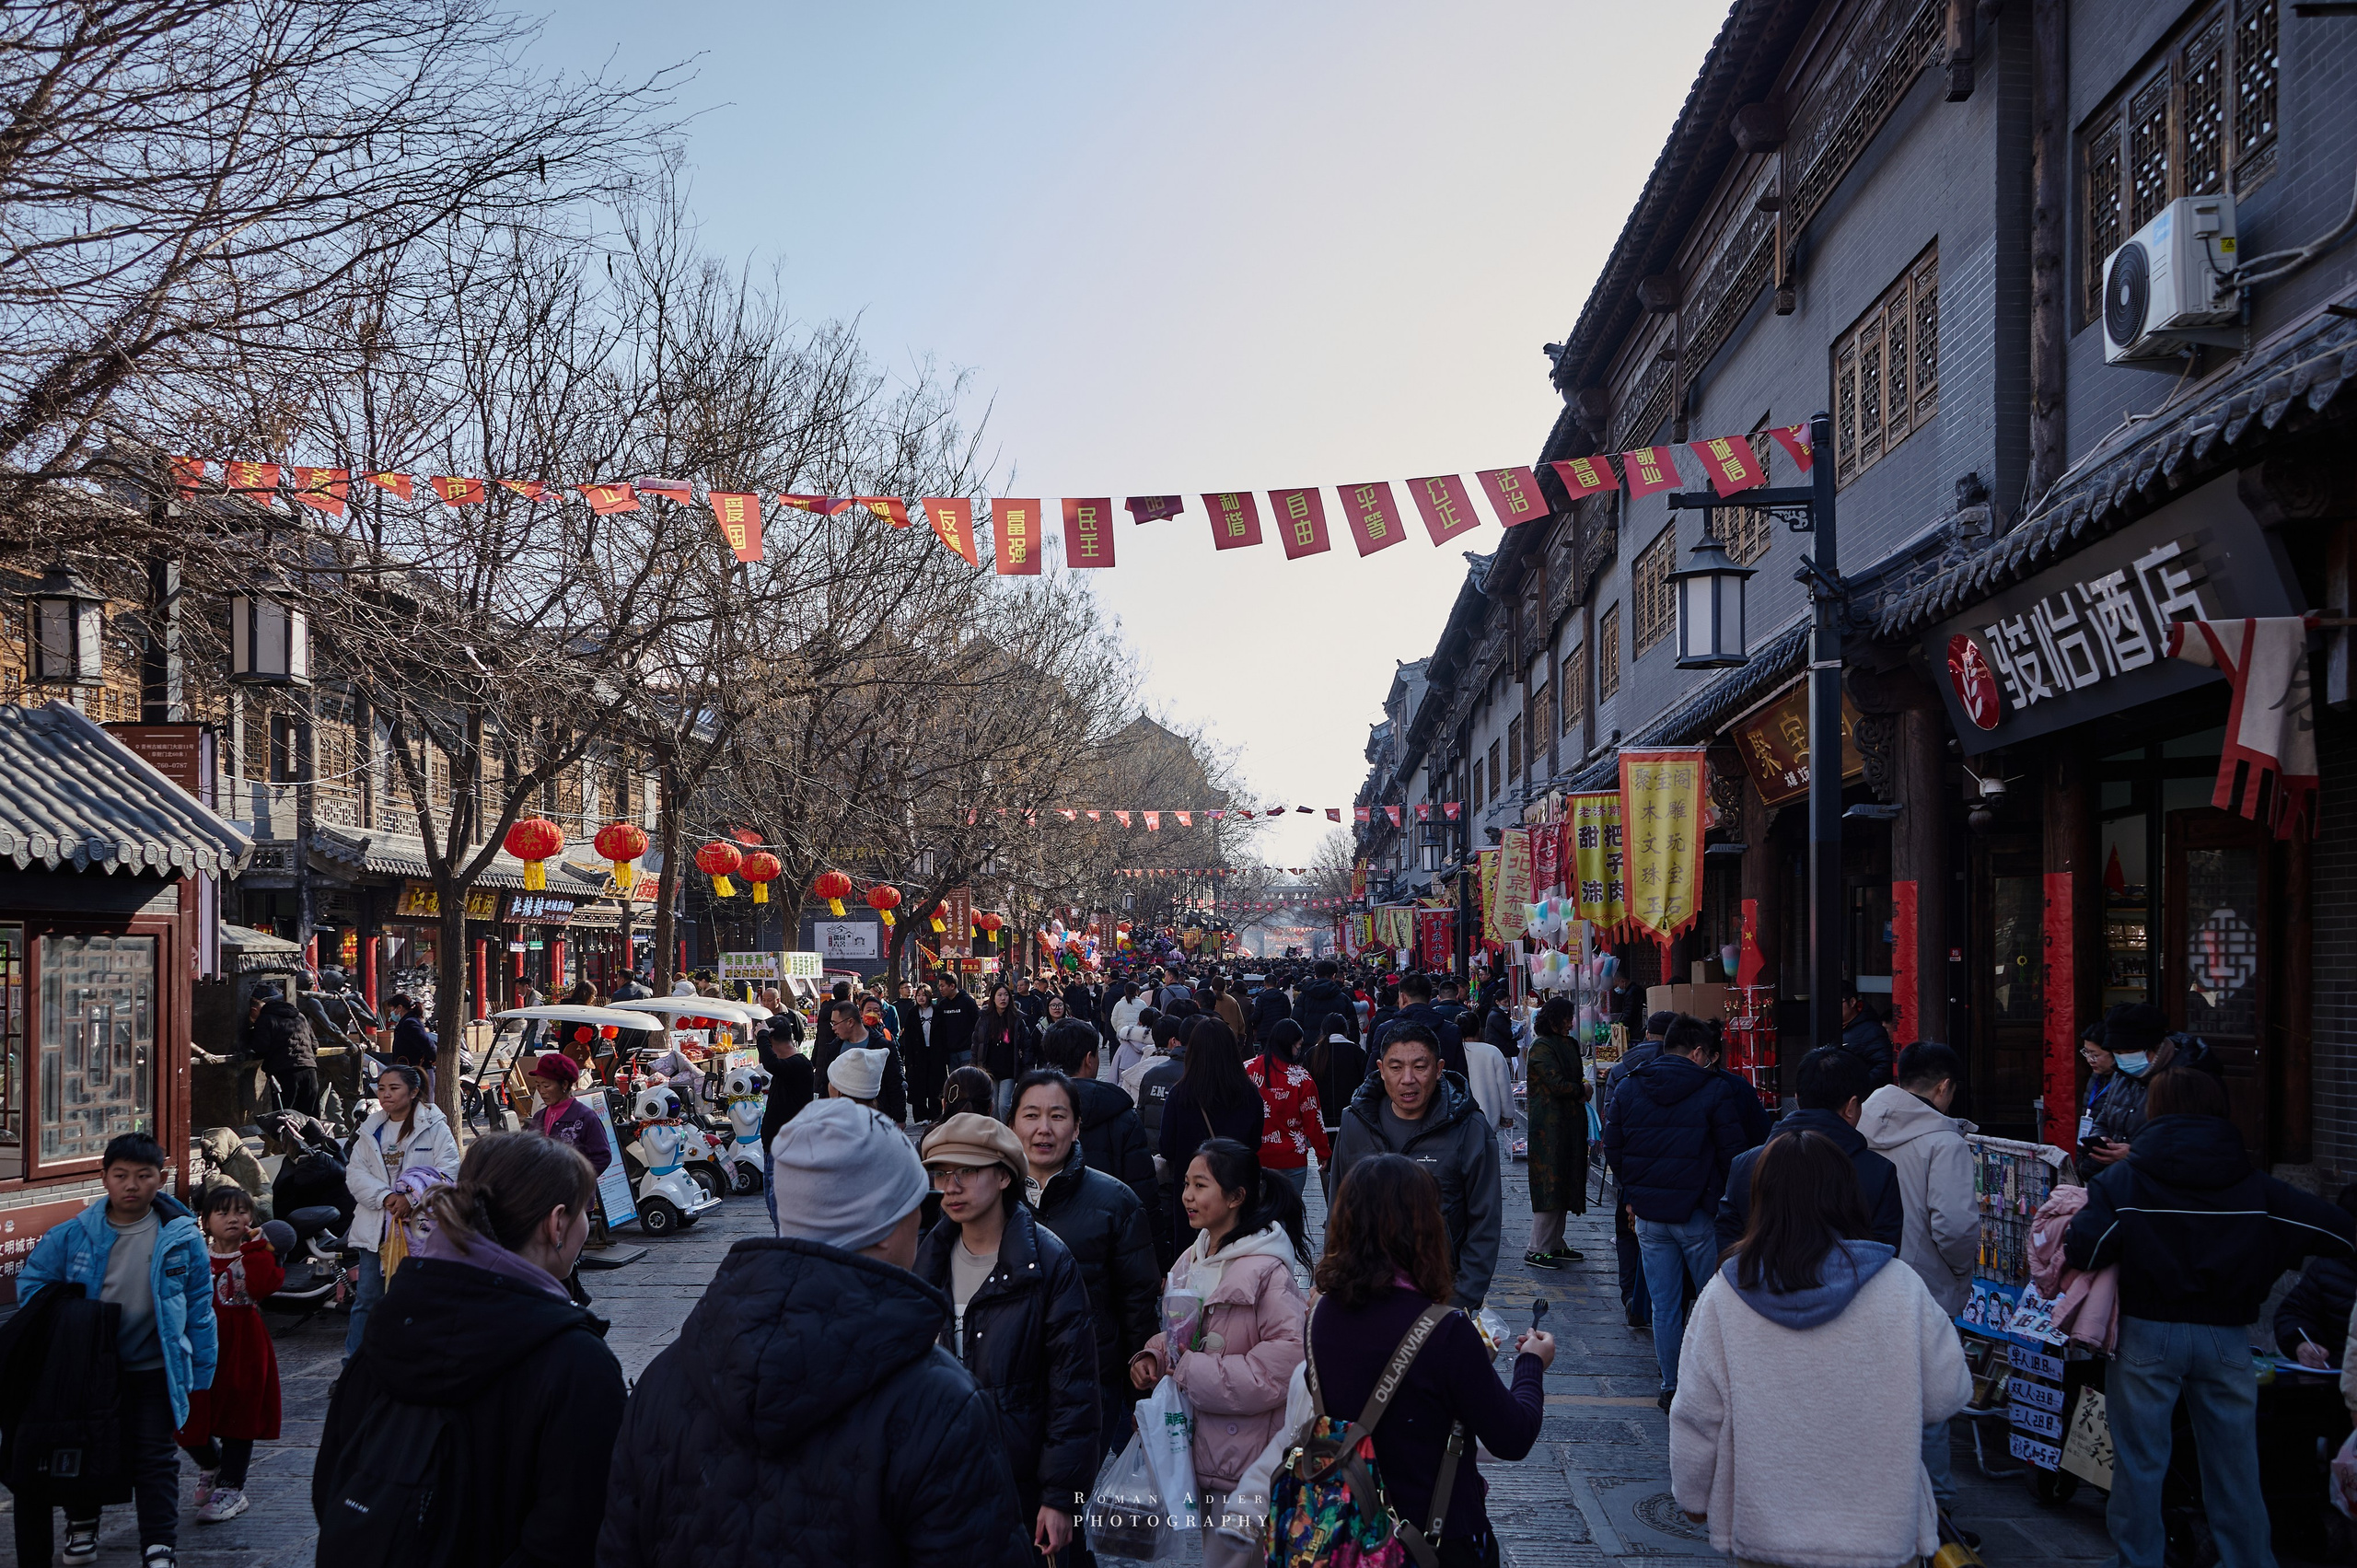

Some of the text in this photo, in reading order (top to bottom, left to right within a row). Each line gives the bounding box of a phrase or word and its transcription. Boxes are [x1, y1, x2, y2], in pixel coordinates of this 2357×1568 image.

[1568, 457, 1601, 488] 爱国
[1634, 447, 1664, 484] 敬业
[1707, 436, 1747, 482] 诚信
[1354, 484, 1387, 540] 平等
[1425, 477, 1461, 529] 公正
[1494, 469, 1529, 515] 法治
[725, 497, 747, 550] 爱国
[1006, 509, 1027, 563] 富强
[1077, 506, 1099, 557] 民主
[1219, 493, 1246, 537] 和谐
[1285, 491, 1314, 546] 自由
[1984, 540, 2208, 710] 骏怡酒店
[1634, 768, 1690, 792] 聚宝阁
[1577, 805, 1621, 819] 老济南
[1641, 799, 1688, 823] 木雕
[1539, 840, 1557, 858] 古
[1577, 825, 1604, 903] 甜沫
[1603, 824, 1624, 902] 把子肉
[1641, 831, 1686, 854] 文玩
[1500, 836, 1531, 930] 老北京布鞋
[1641, 862, 1684, 887] 珠宝
[464, 892, 496, 914] 休闲
[1643, 895, 1682, 914] 玉石
[1431, 920, 1445, 963] 重庆小面
[0, 1235, 42, 1256] 明城市
